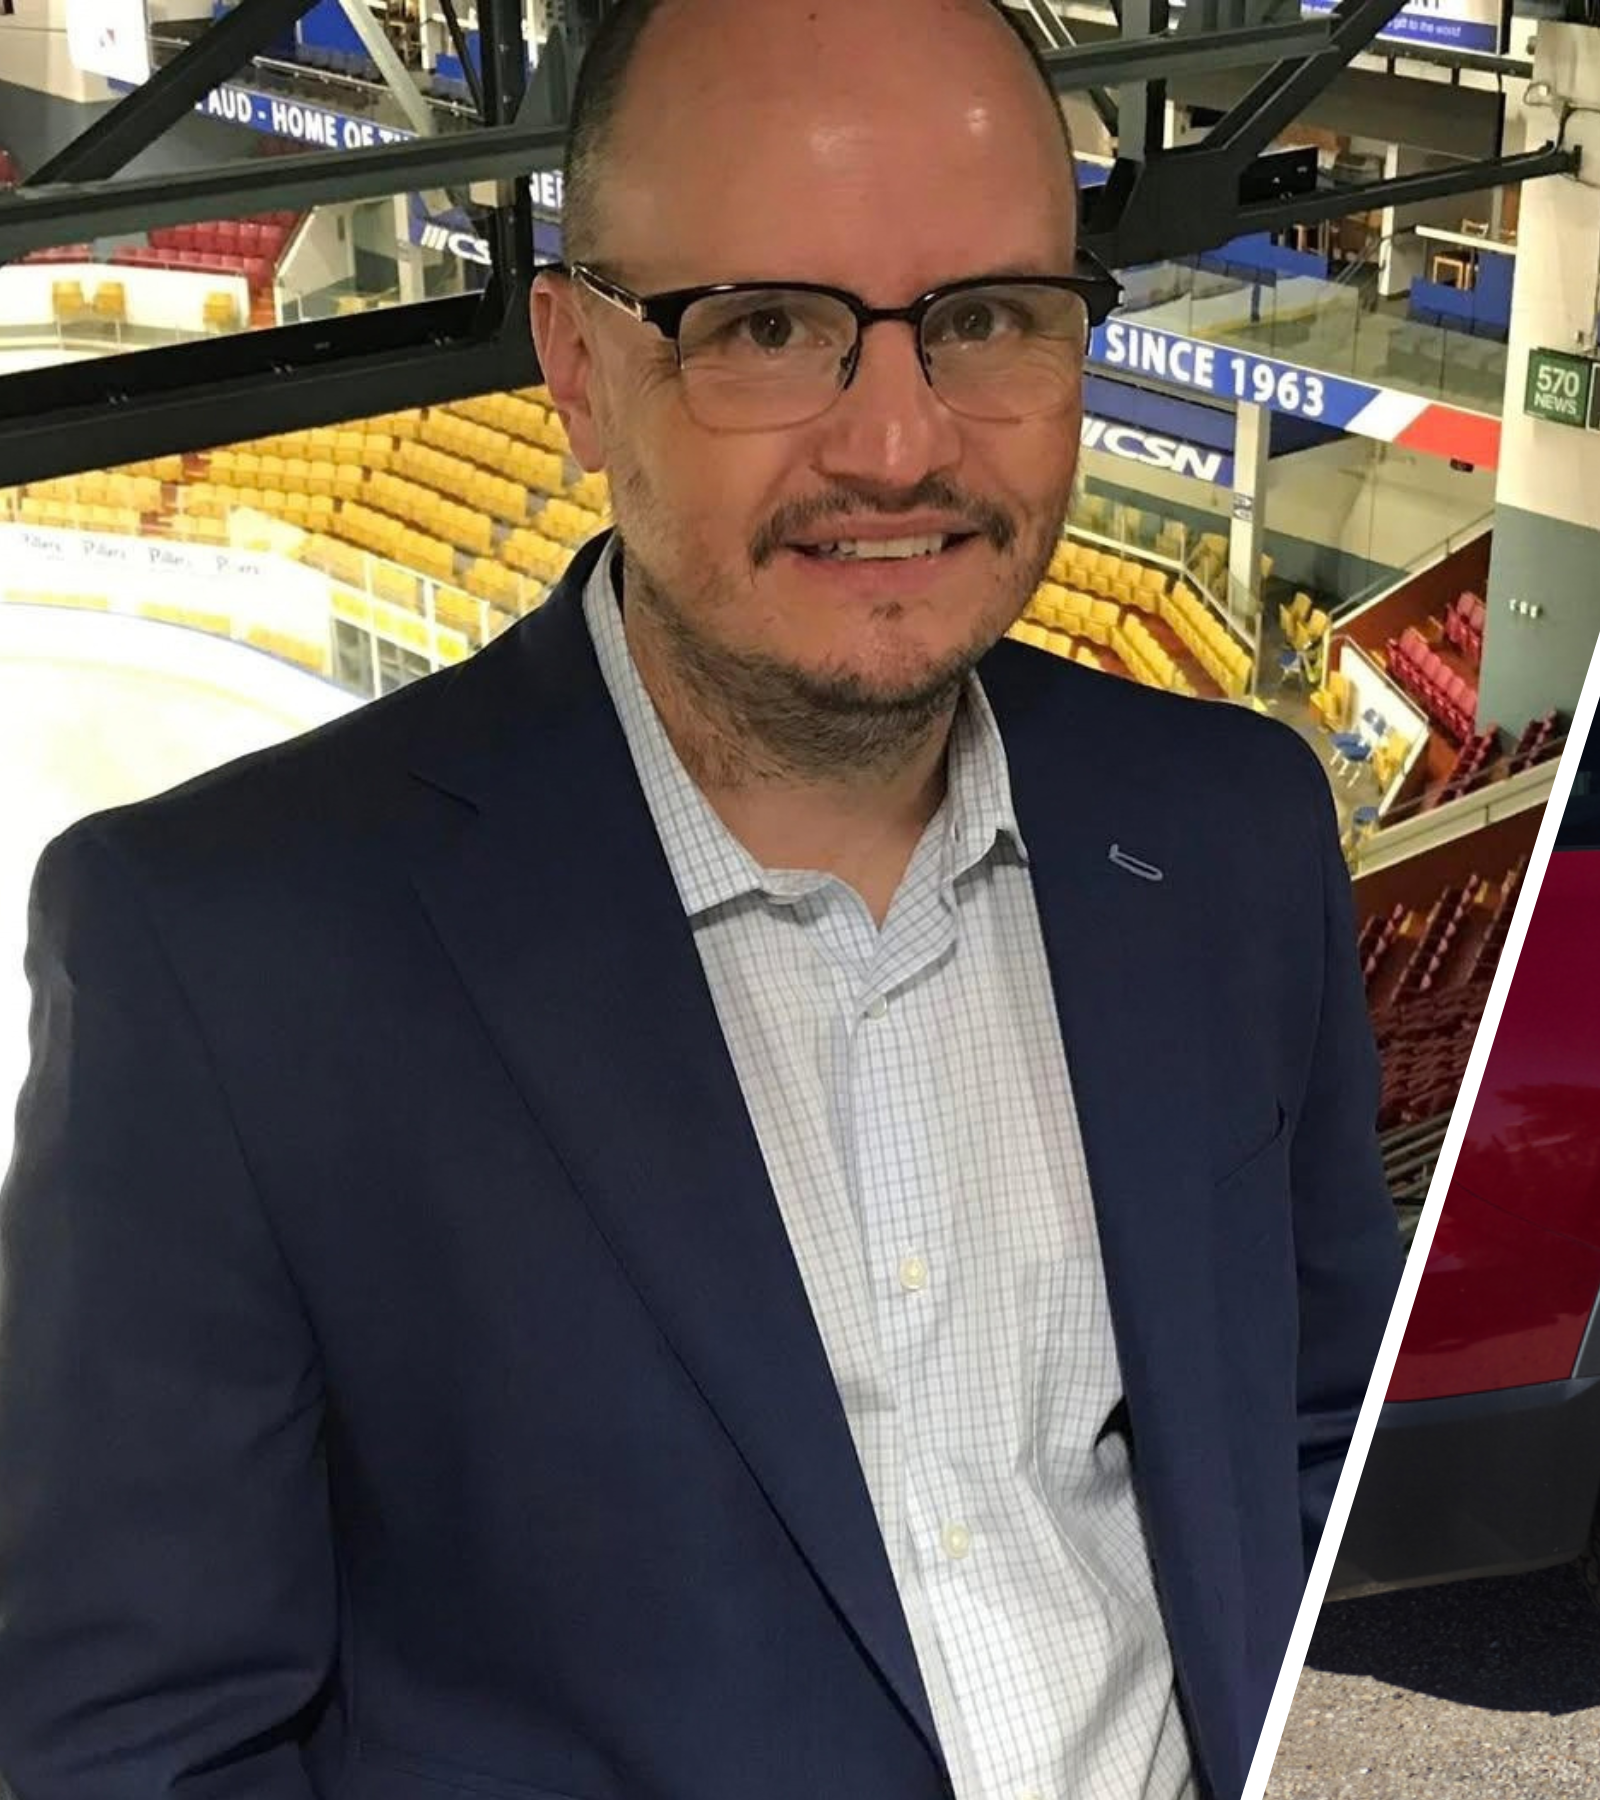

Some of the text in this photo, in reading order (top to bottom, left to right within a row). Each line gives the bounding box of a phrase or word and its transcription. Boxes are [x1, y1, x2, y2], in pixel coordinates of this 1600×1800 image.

[208, 89, 252, 123] AUD
[271, 103, 339, 147] HOME
[1105, 323, 1324, 417] SINCE 1963
[1536, 365, 1580, 398] 570
[1533, 391, 1578, 416] NEWS
